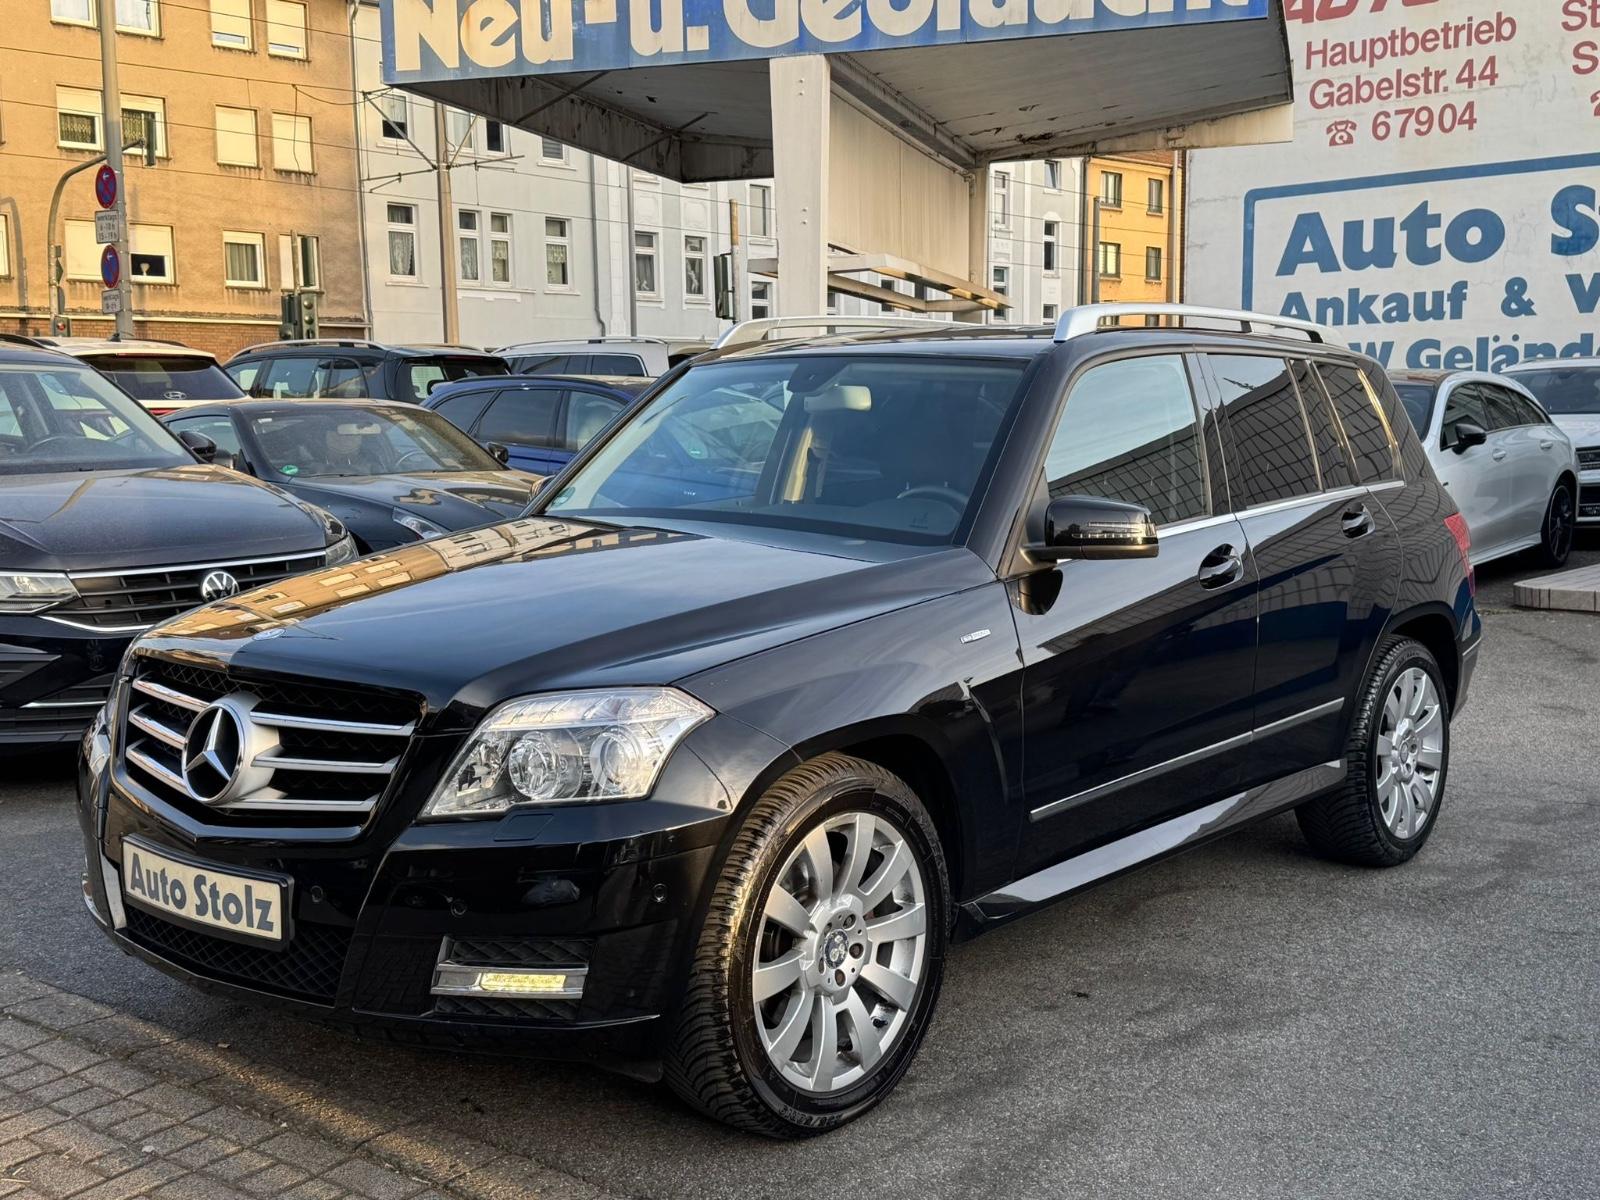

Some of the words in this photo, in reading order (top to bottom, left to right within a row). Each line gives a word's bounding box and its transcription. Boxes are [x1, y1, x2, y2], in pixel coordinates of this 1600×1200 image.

[1305, 11, 1517, 70] Hauptbetrieb
[1309, 68, 1449, 110] Gabelstr.
[1456, 55, 1499, 89] 44
[1371, 101, 1477, 141] 67904
[1275, 200, 1506, 277] Auto
[1551, 184, 1600, 256] S
[1279, 280, 1468, 326] Ankauf
[1500, 276, 1537, 318] &
[1405, 333, 1600, 374] Geländ
[130, 852, 187, 910] Auto
[193, 874, 274, 932] Stolz
